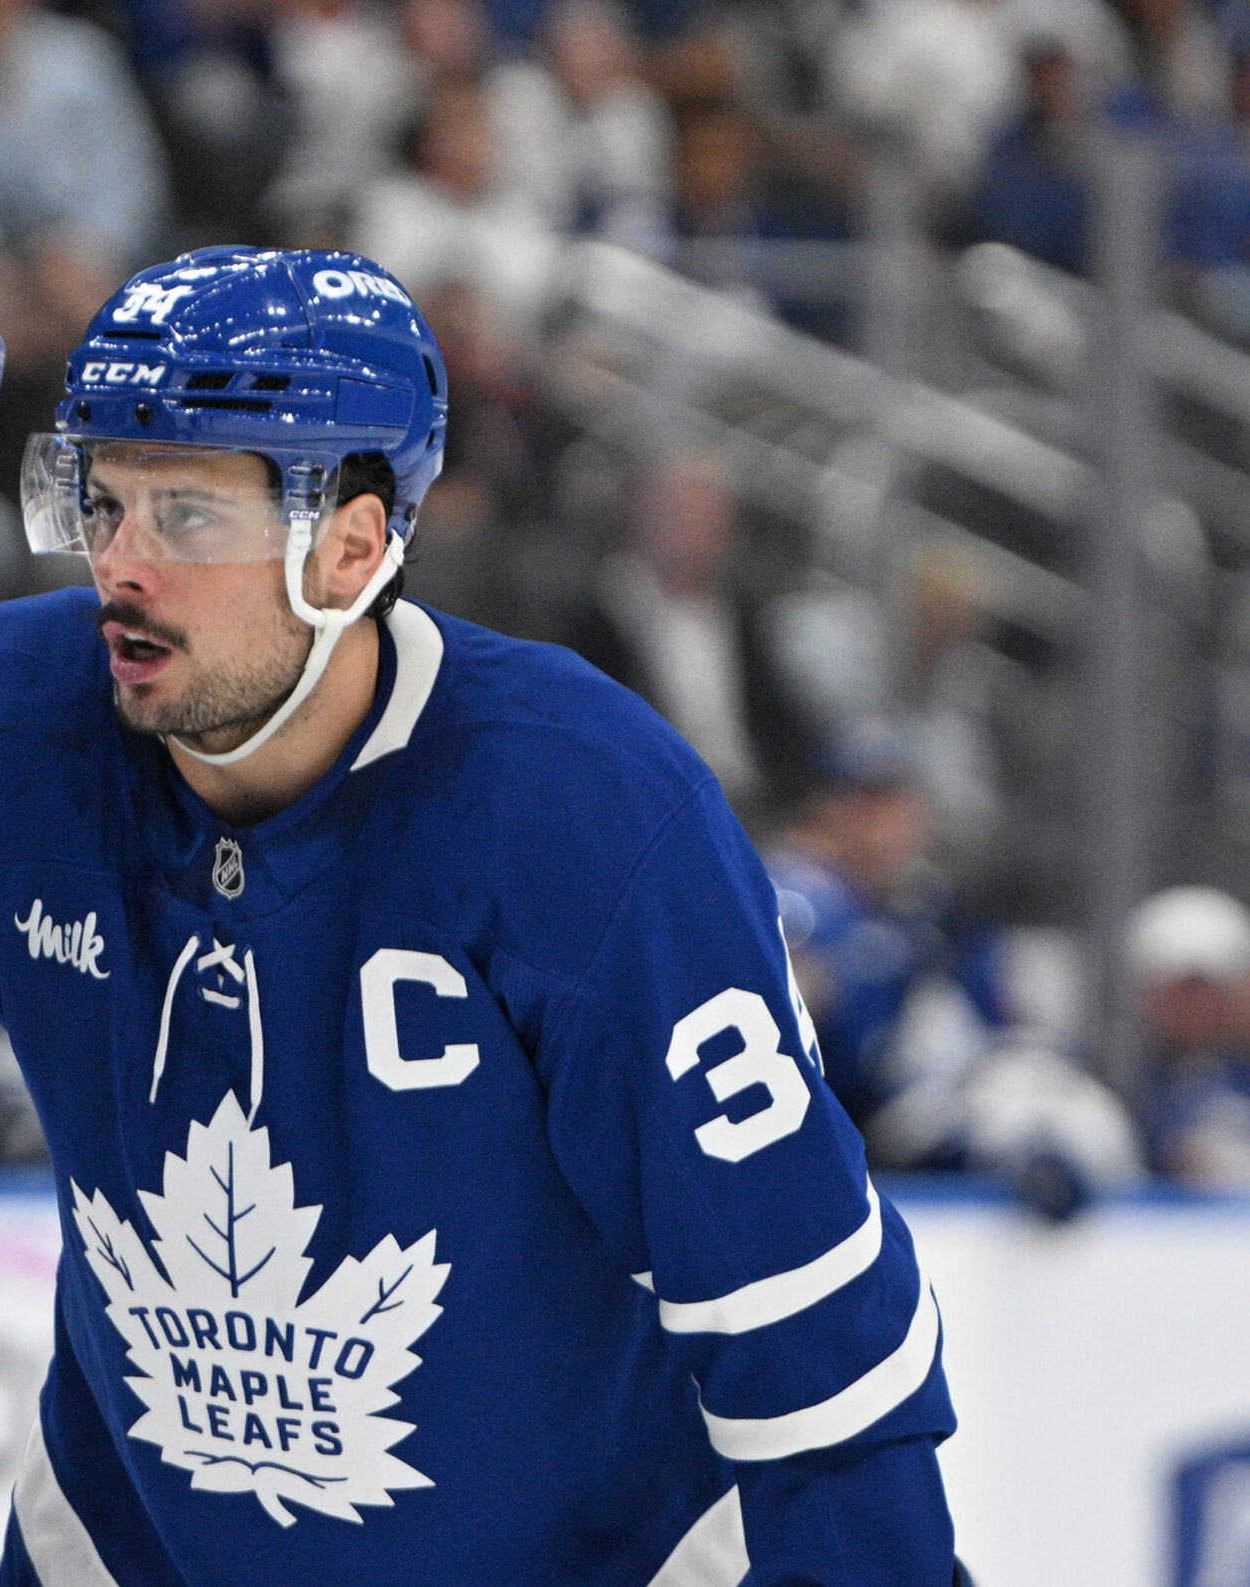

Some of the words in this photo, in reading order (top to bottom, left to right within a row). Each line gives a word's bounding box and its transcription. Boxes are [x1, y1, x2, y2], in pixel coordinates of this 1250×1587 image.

[82, 362, 166, 386] CCM
[289, 510, 320, 520] CCM
[220, 856, 239, 884] NHL
[14, 898, 111, 979] Milk
[360, 948, 480, 1091] C
[665, 915, 825, 1164] 3
[129, 1306, 375, 1379] TORONTO
[170, 1352, 337, 1412] MAPLE
[177, 1395, 343, 1455] LEAFS
